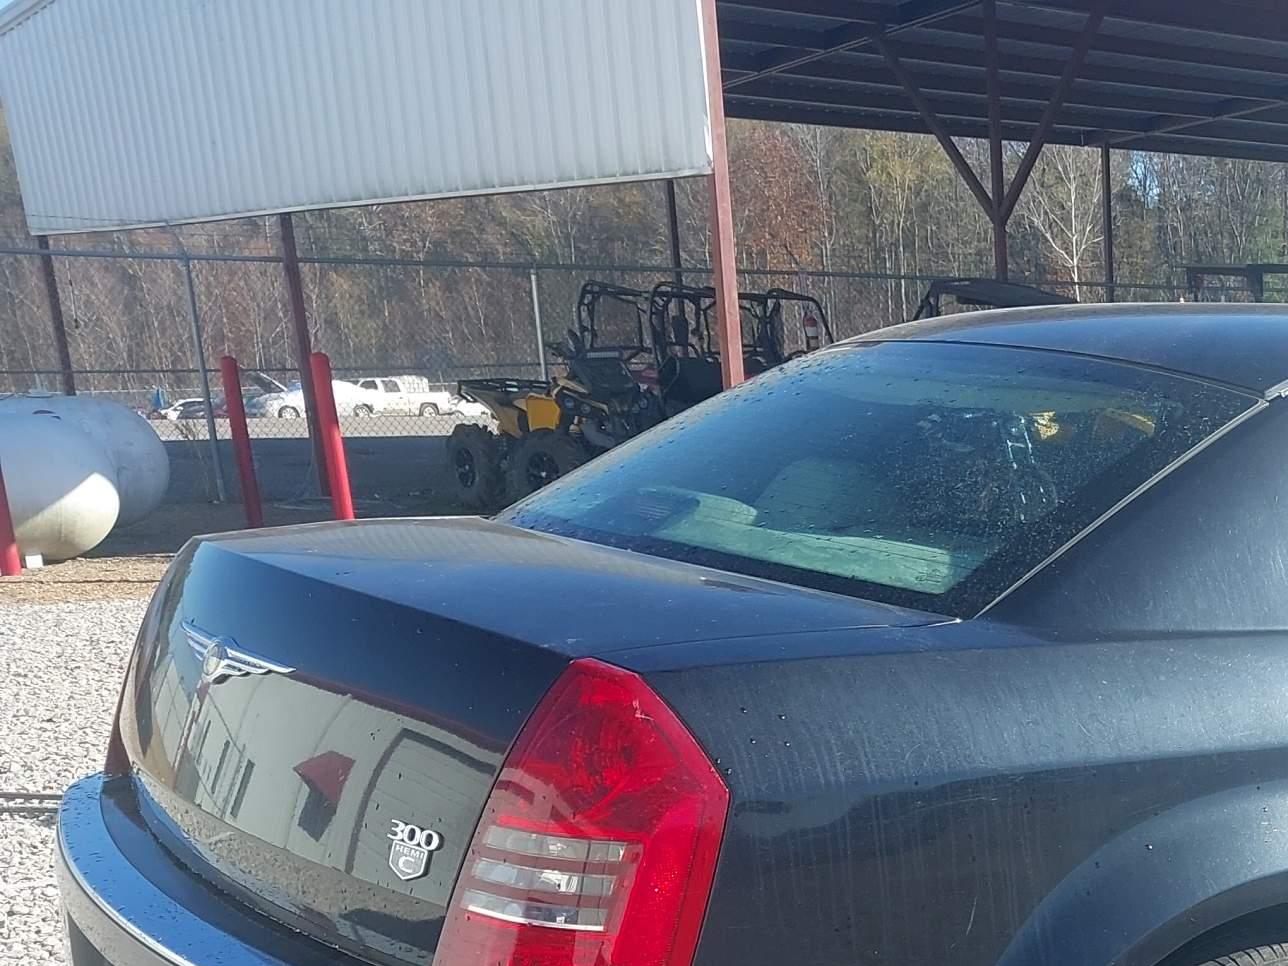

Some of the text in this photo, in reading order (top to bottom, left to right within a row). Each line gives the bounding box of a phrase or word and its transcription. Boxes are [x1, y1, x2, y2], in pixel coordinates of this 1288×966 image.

[387, 819, 440, 850] 300
[395, 844, 424, 859] HEMI
[398, 856, 415, 874] C
